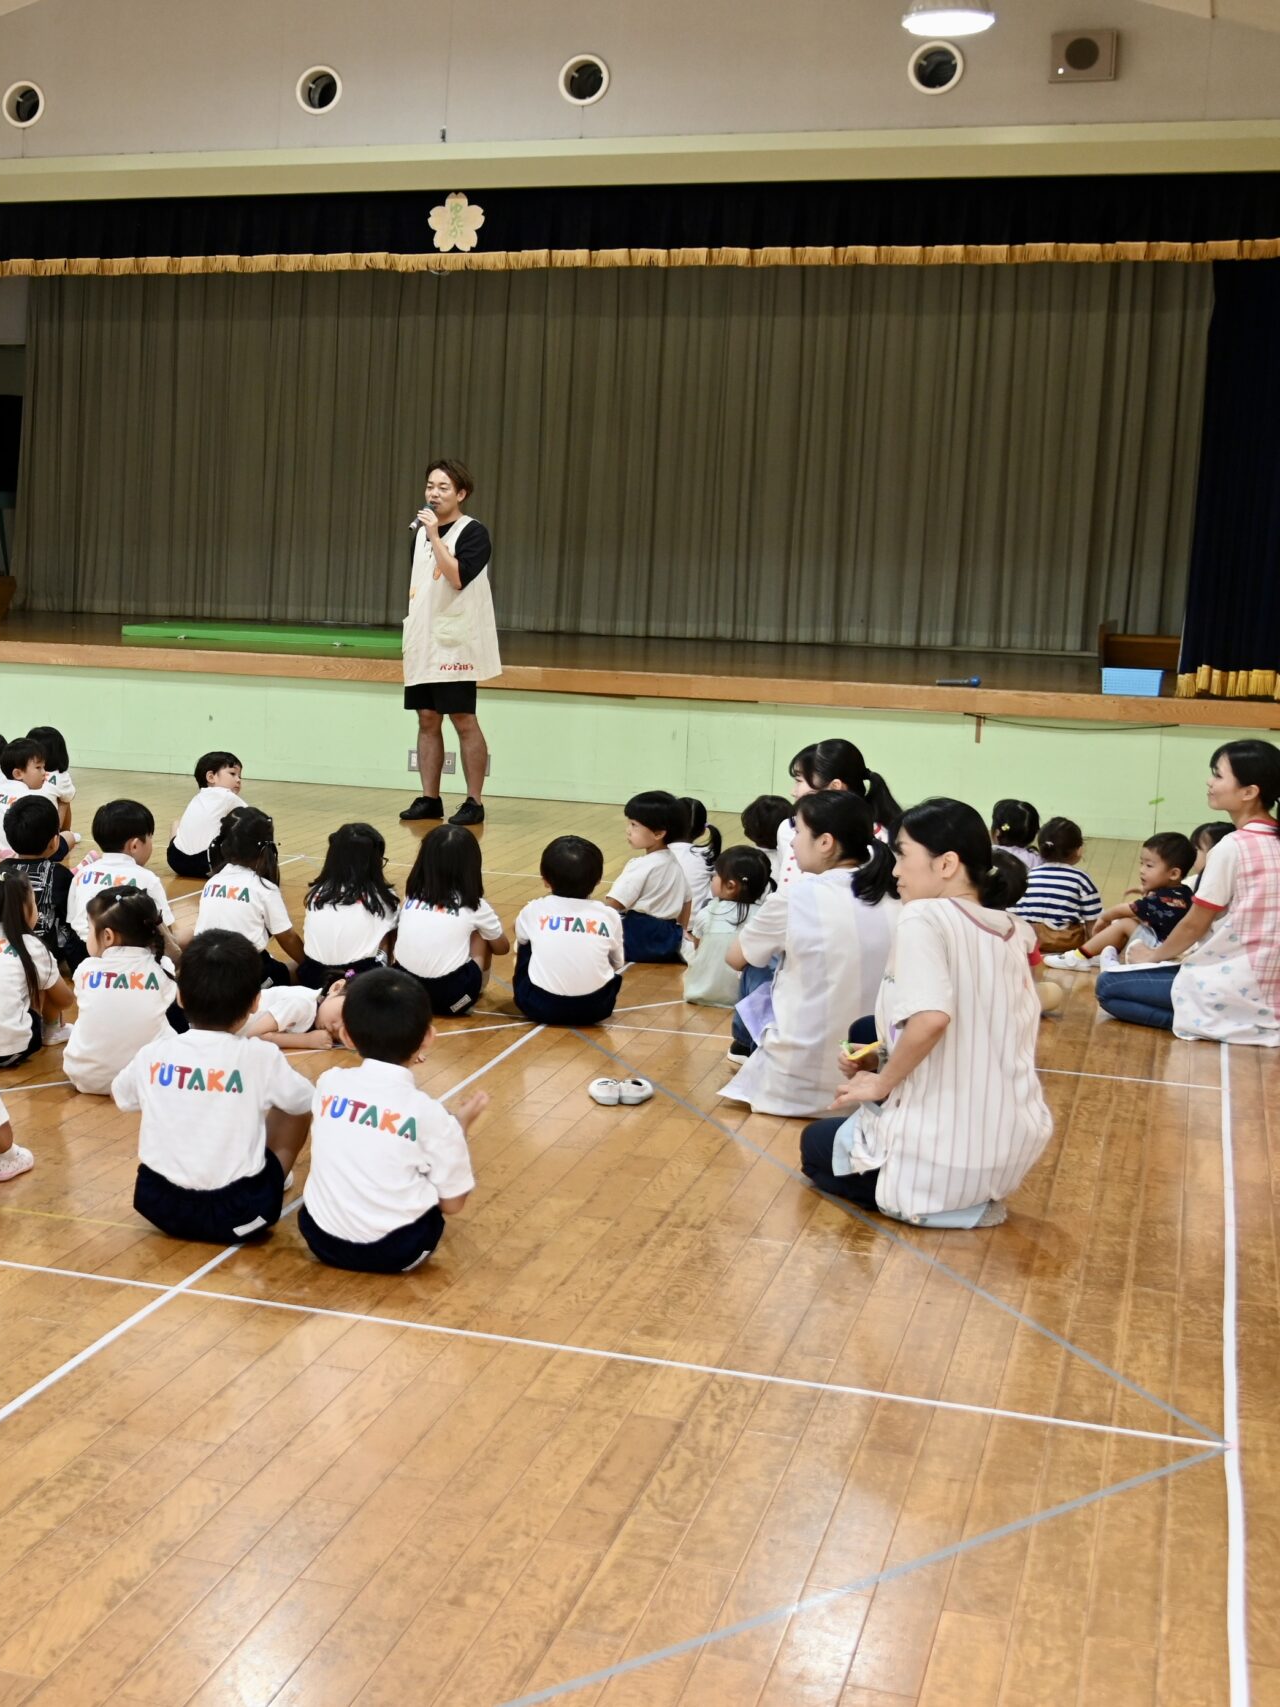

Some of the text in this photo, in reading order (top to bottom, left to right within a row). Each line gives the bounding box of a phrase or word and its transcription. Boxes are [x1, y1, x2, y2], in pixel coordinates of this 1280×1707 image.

[204, 884, 250, 903] UTAKA
[540, 915, 610, 937] YUTAKA
[81, 971, 160, 990] YUTAKA
[150, 1062, 243, 1093] YUTAKA
[321, 1095, 416, 1141] YUTAKA
